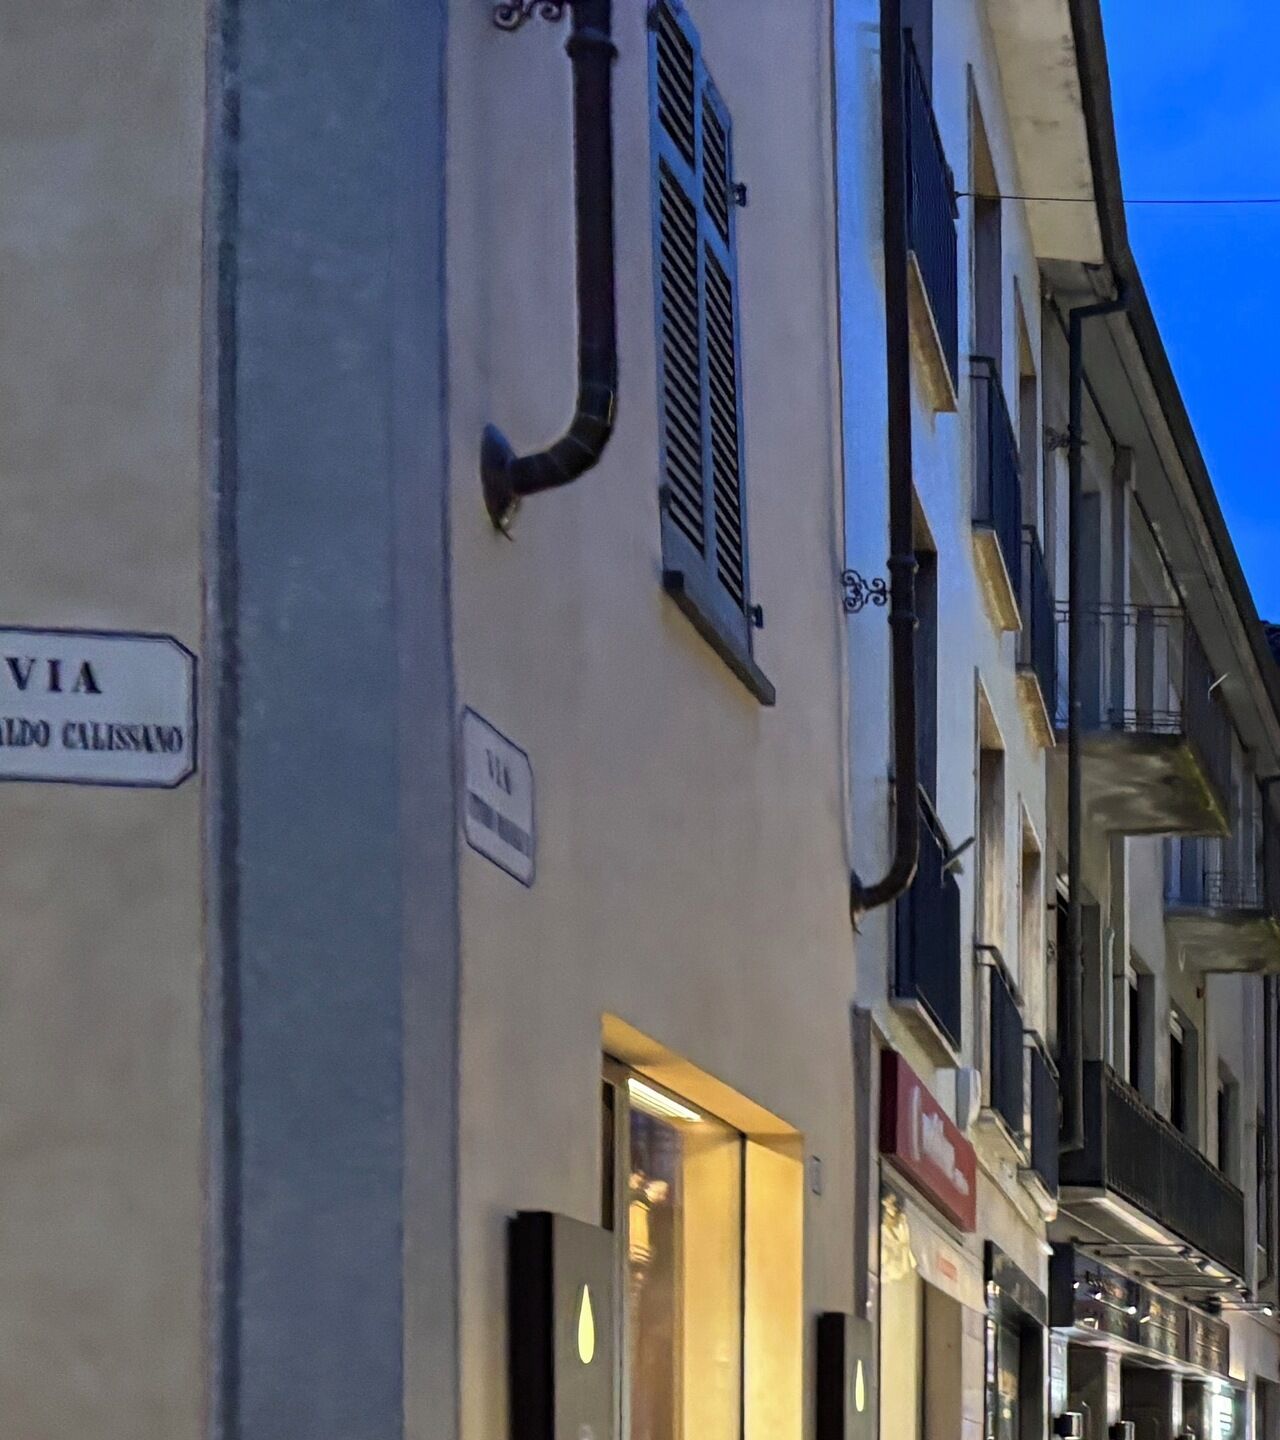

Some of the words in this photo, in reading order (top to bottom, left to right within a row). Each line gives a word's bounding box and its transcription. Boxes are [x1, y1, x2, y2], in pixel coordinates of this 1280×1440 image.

[6, 656, 103, 694] VIA
[0, 716, 50, 748] LDO
[62, 718, 184, 753] CALISSANO
